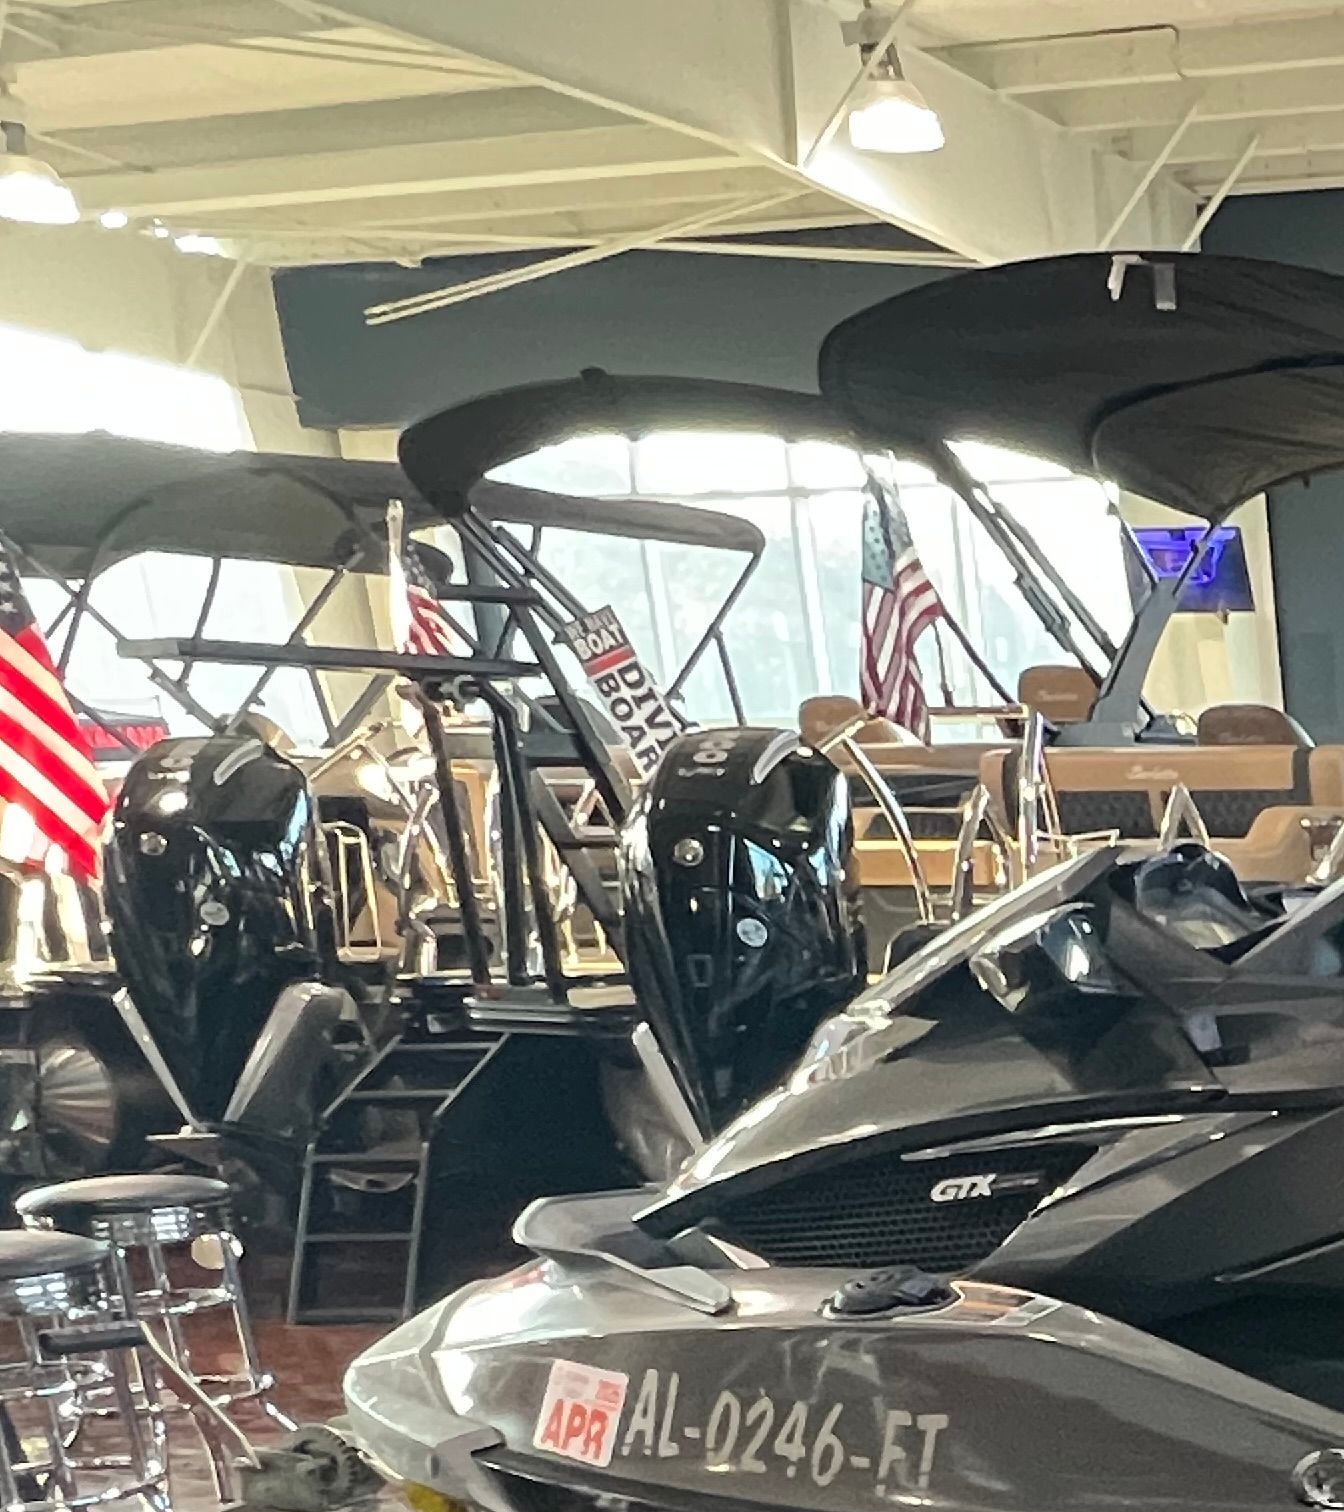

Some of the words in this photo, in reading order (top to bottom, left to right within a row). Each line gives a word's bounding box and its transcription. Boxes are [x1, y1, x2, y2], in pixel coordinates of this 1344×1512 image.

[573, 624, 625, 660] BOAT
[930, 1172, 997, 1202] GTX
[540, 1398, 609, 1460] APR
